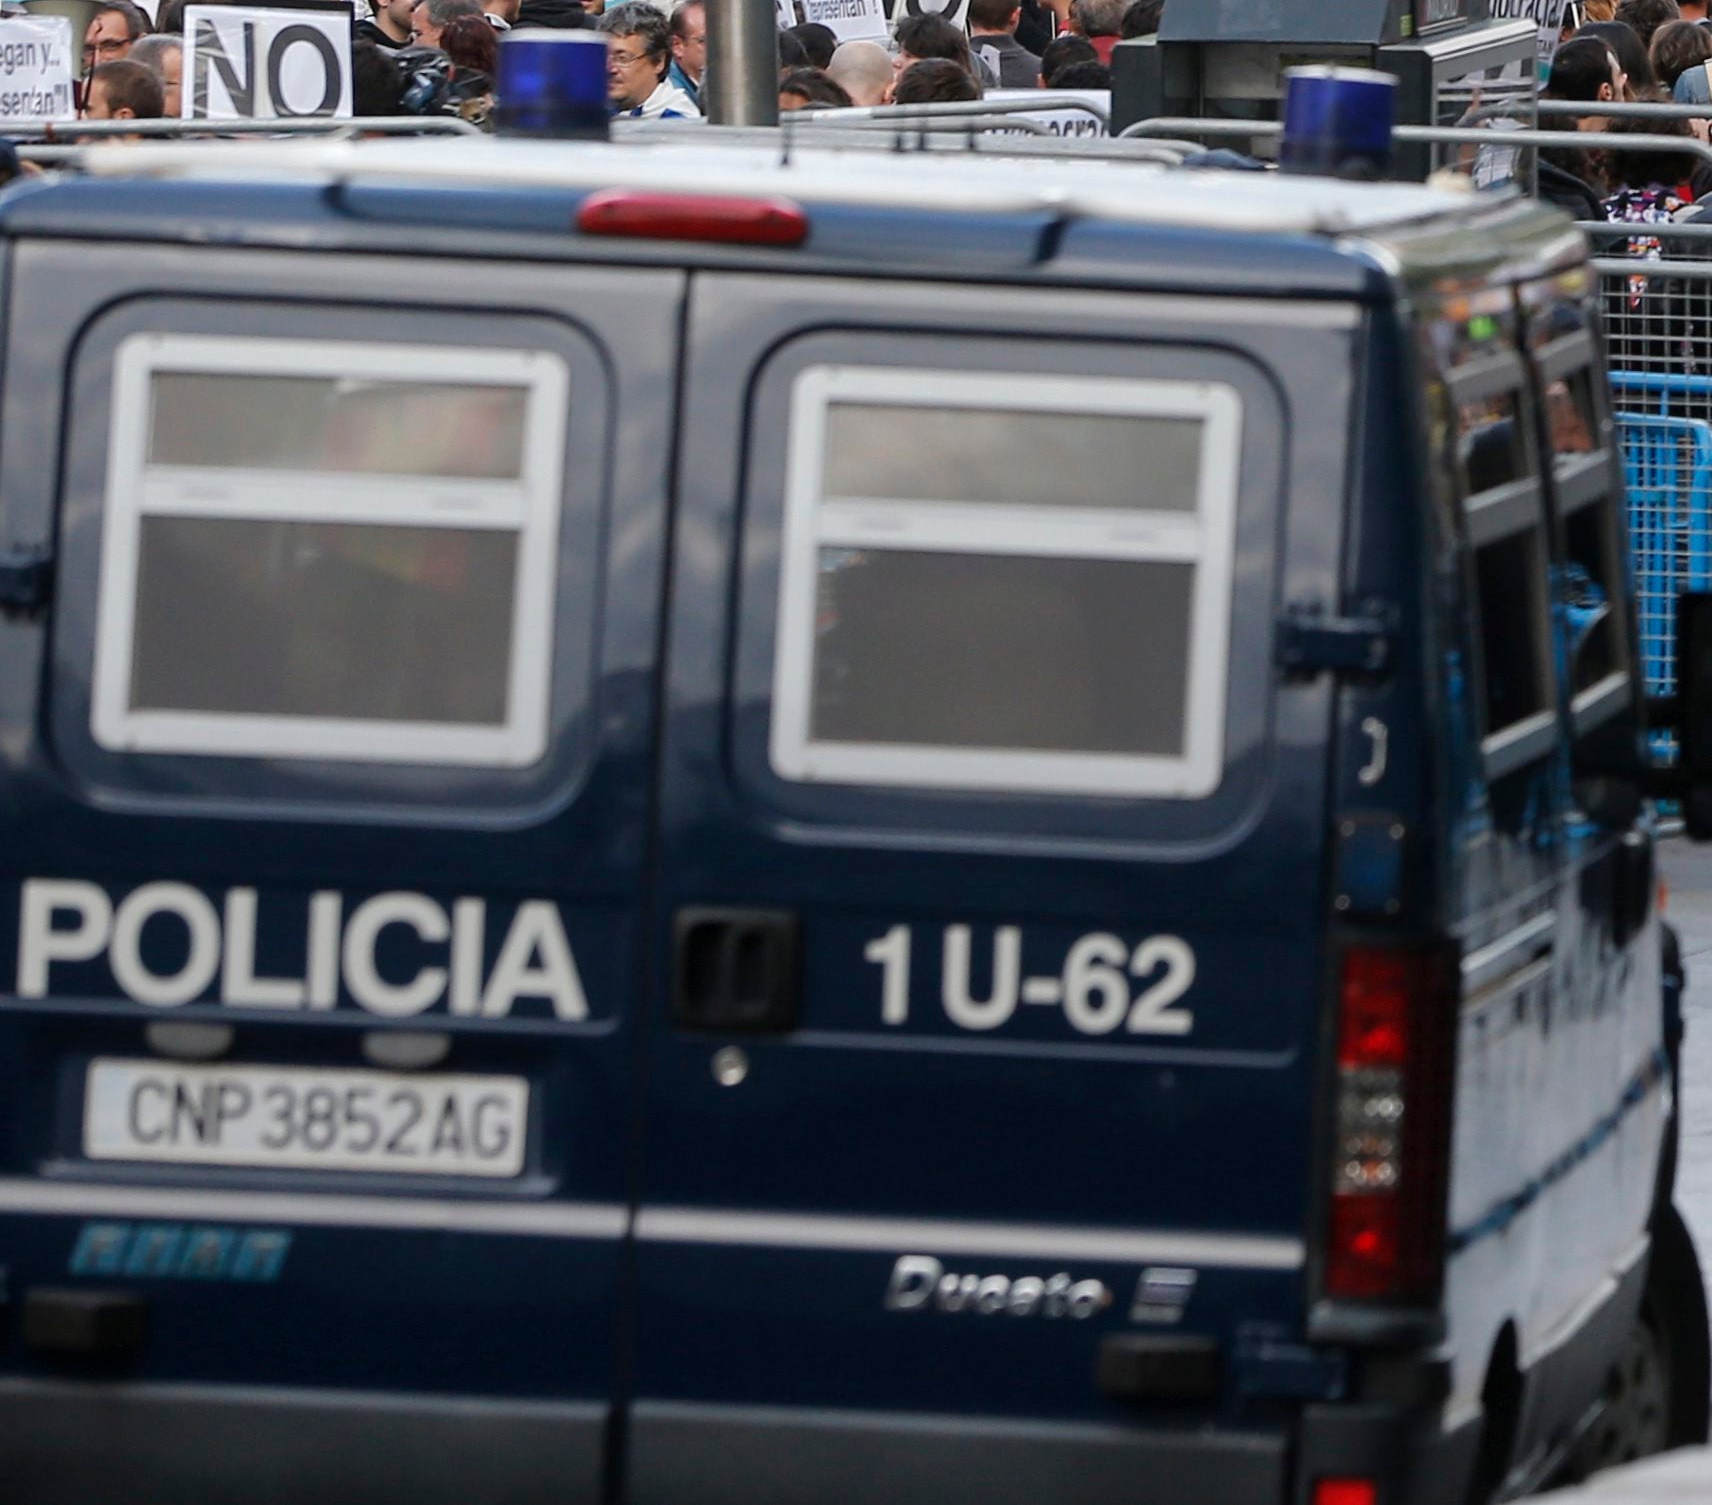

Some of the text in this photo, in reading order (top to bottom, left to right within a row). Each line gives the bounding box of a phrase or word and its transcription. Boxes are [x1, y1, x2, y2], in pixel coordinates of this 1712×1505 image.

[193, 20, 342, 118] NO
[15, 878, 588, 1022] POLICIA
[886, 1250, 1108, 1321] Ducato
